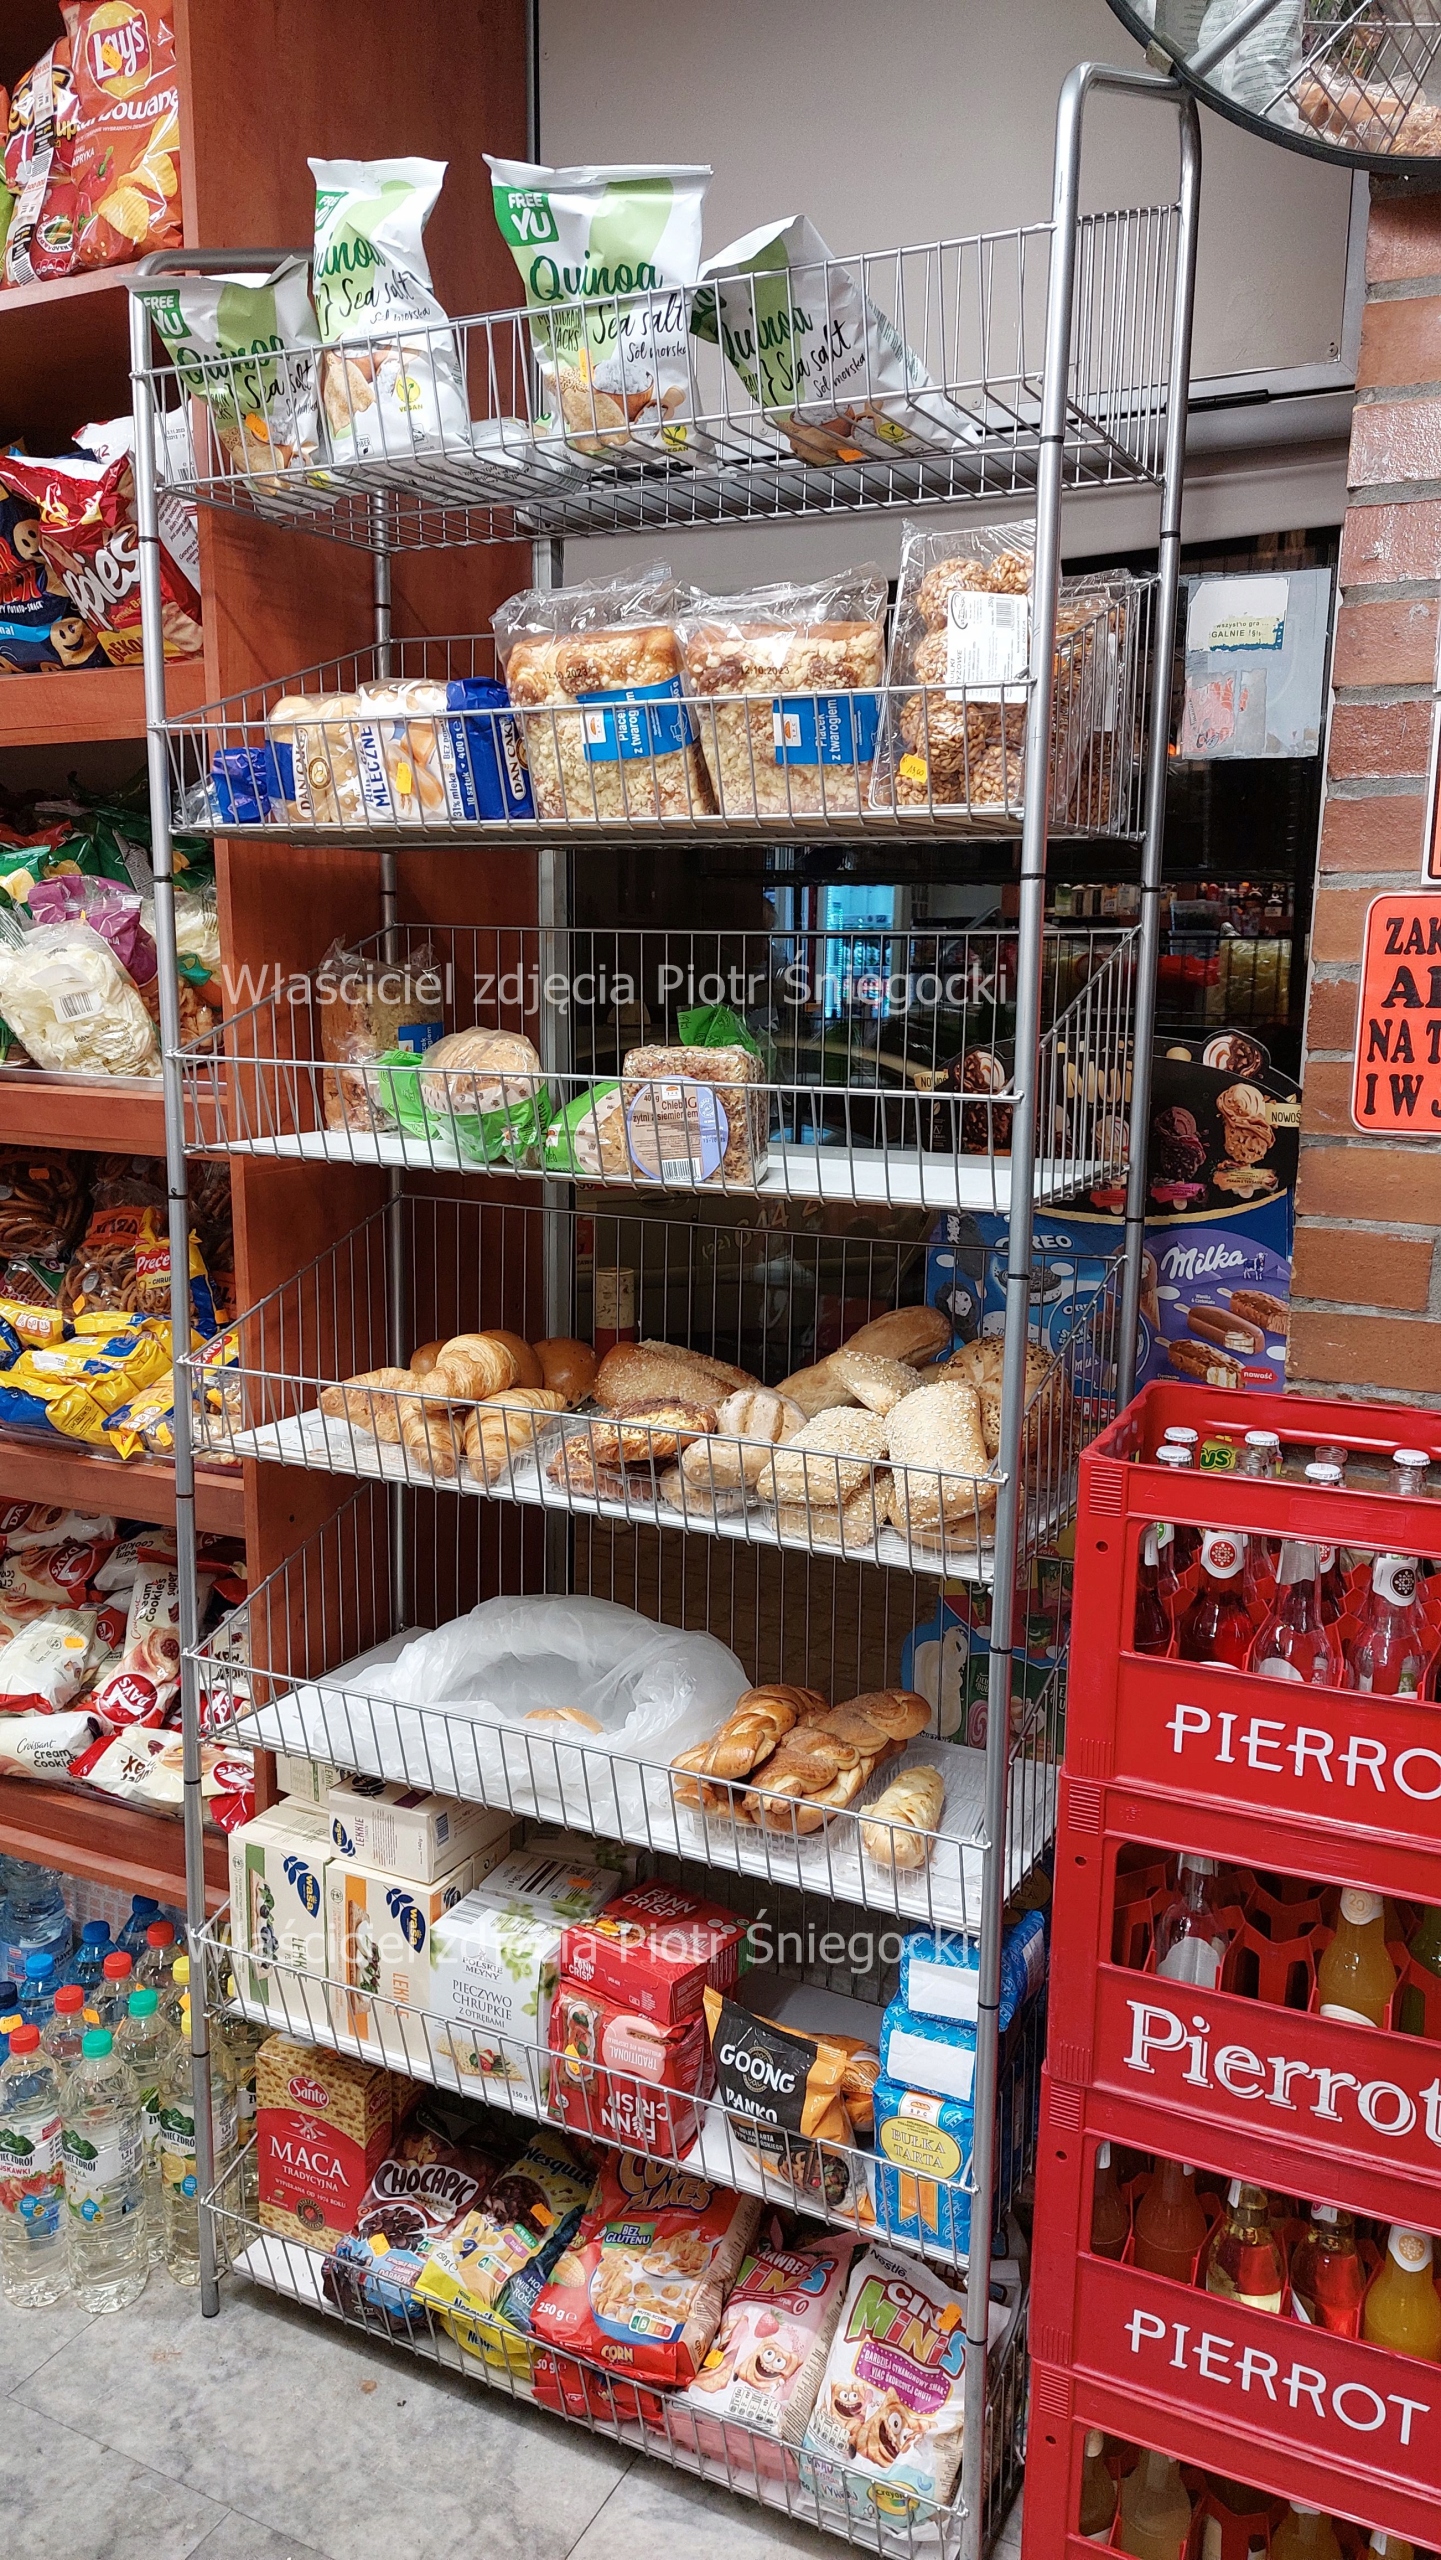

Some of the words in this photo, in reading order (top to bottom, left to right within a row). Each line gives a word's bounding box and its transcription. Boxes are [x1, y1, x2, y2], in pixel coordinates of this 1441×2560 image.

[72, 148, 95, 168] APRYKA
[508, 193, 543, 209] FREE
[511, 208, 552, 240] YU
[529, 250, 663, 300] Quinoa
[143, 295, 175, 309] FREE
[339, 278, 379, 317] Sea
[384, 270, 414, 304] salt
[152, 309, 184, 336] YU
[592, 304, 636, 344] Sea
[642, 292, 691, 336] salt
[627, 342, 647, 362] Sól
[776, 352, 811, 391] Sea
[244, 375, 285, 409] Sea
[1210, 630, 1246, 638] GALNIE
[740, 665, 790, 676] 12.10.2023
[508, 766, 523, 795] DAN
[1366, 1018, 1416, 1063] NA
[661, 1100, 683, 1111] Chleb
[1363, 1074, 1377, 1116] I
[1388, 1074, 1424, 1117] W
[1160, 1243, 1248, 1281] Milka
[1243, 1370, 1273, 1380] nowość
[1201, 1448, 1231, 1469] US
[118, 1675, 152, 1710] DAYS
[305, 1874, 315, 1911] wasa
[621, 1893, 677, 1917] CRISP
[408, 1907, 419, 1947] wasa
[291, 1936, 309, 1983] LEKKE
[462, 1956, 504, 1975] POLSKIE
[465, 1964, 500, 1981] MŁYNY
[568, 1964, 593, 1982] CRISP
[392, 1972, 409, 2019] LEKKE
[452, 1979, 513, 2008] PIECZYWO
[452, 1991, 513, 2021] CHRUPKIE
[465, 2008, 505, 2028] OTRĘBAMI
[609, 2045, 658, 2071] TRADITIONAL
[720, 2043, 796, 2094] GOONG
[292, 2078, 327, 2105] Sante
[511, 2090, 523, 2099] 150
[725, 2085, 778, 2124] PANKO
[891, 2128, 946, 2155] BUŁKA
[269, 2135, 351, 2188] MACA
[523, 2145, 597, 2189] Nesquik
[893, 2143, 944, 2169] TARTA
[282, 2164, 339, 2193] TRADYCYJNA
[374, 2159, 479, 2207] CHOCAPIC
[605, 2230, 651, 2246] GLUTENU
[622, 2224, 640, 2236] BEZ
[536, 2301, 557, 2315] 250
[600, 2344, 634, 2364] CORN
[864, 2351, 892, 2370] BARDZIEJ
[892, 2364, 929, 2389] CYNAMONOWY
[929, 2382, 946, 2396] SMAK
[1124, 2308, 1431, 2446] PIERROT
[914, 2388, 932, 2402] CHUTI
